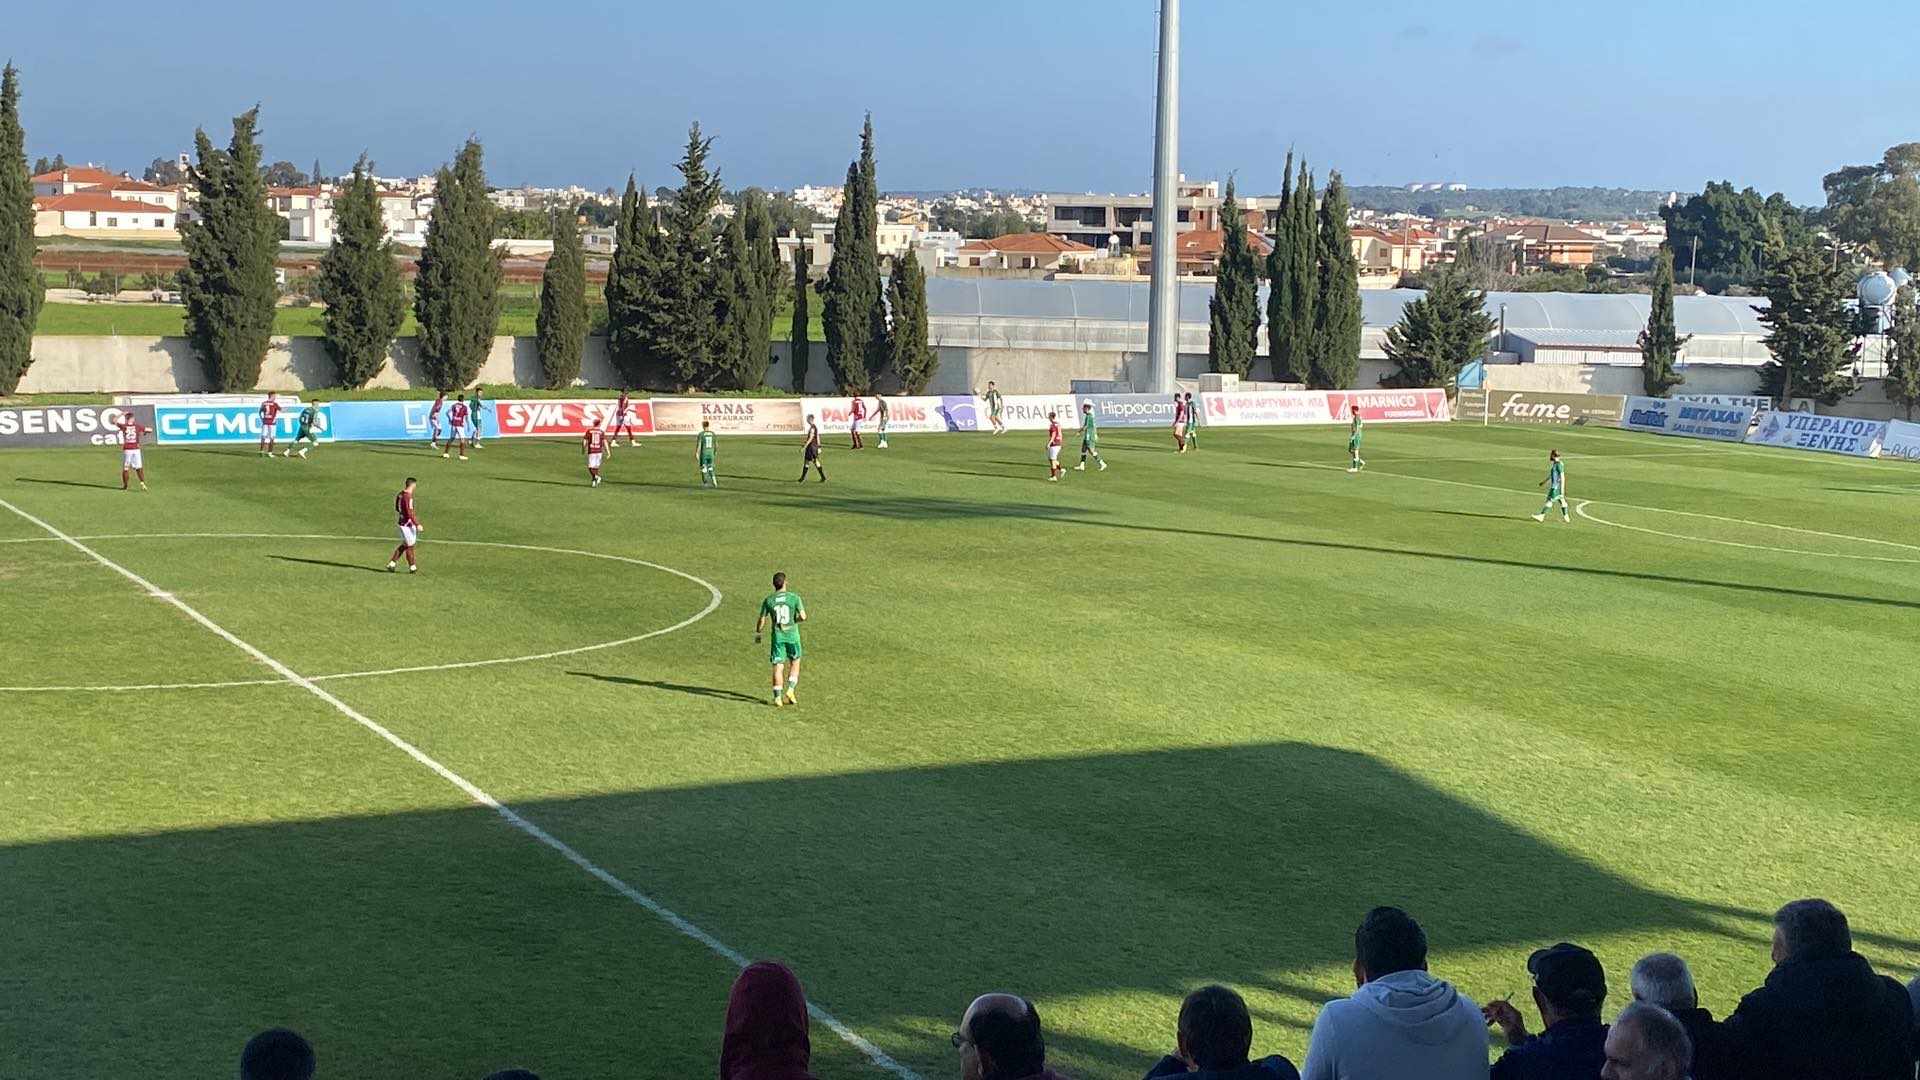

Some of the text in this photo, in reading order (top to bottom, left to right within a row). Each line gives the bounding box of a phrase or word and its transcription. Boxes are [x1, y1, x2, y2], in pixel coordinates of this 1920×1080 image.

[701, 403, 754, 415] KANAS
[1101, 400, 1176, 417] Hippocam
[1357, 395, 1417, 408] MARNICO
[1500, 393, 1570, 418] fame
[506, 404, 571, 433] SYM
[1005, 404, 1073, 419] PRIALIFE
[1679, 407, 1744, 424] METAXAS
[1785, 414, 1887, 439] ΥΠΕΡΑΓΟΡΑ
[91, 430, 125, 445] caf
[1797, 432, 1858, 453] ΞΕΝΗΣ
